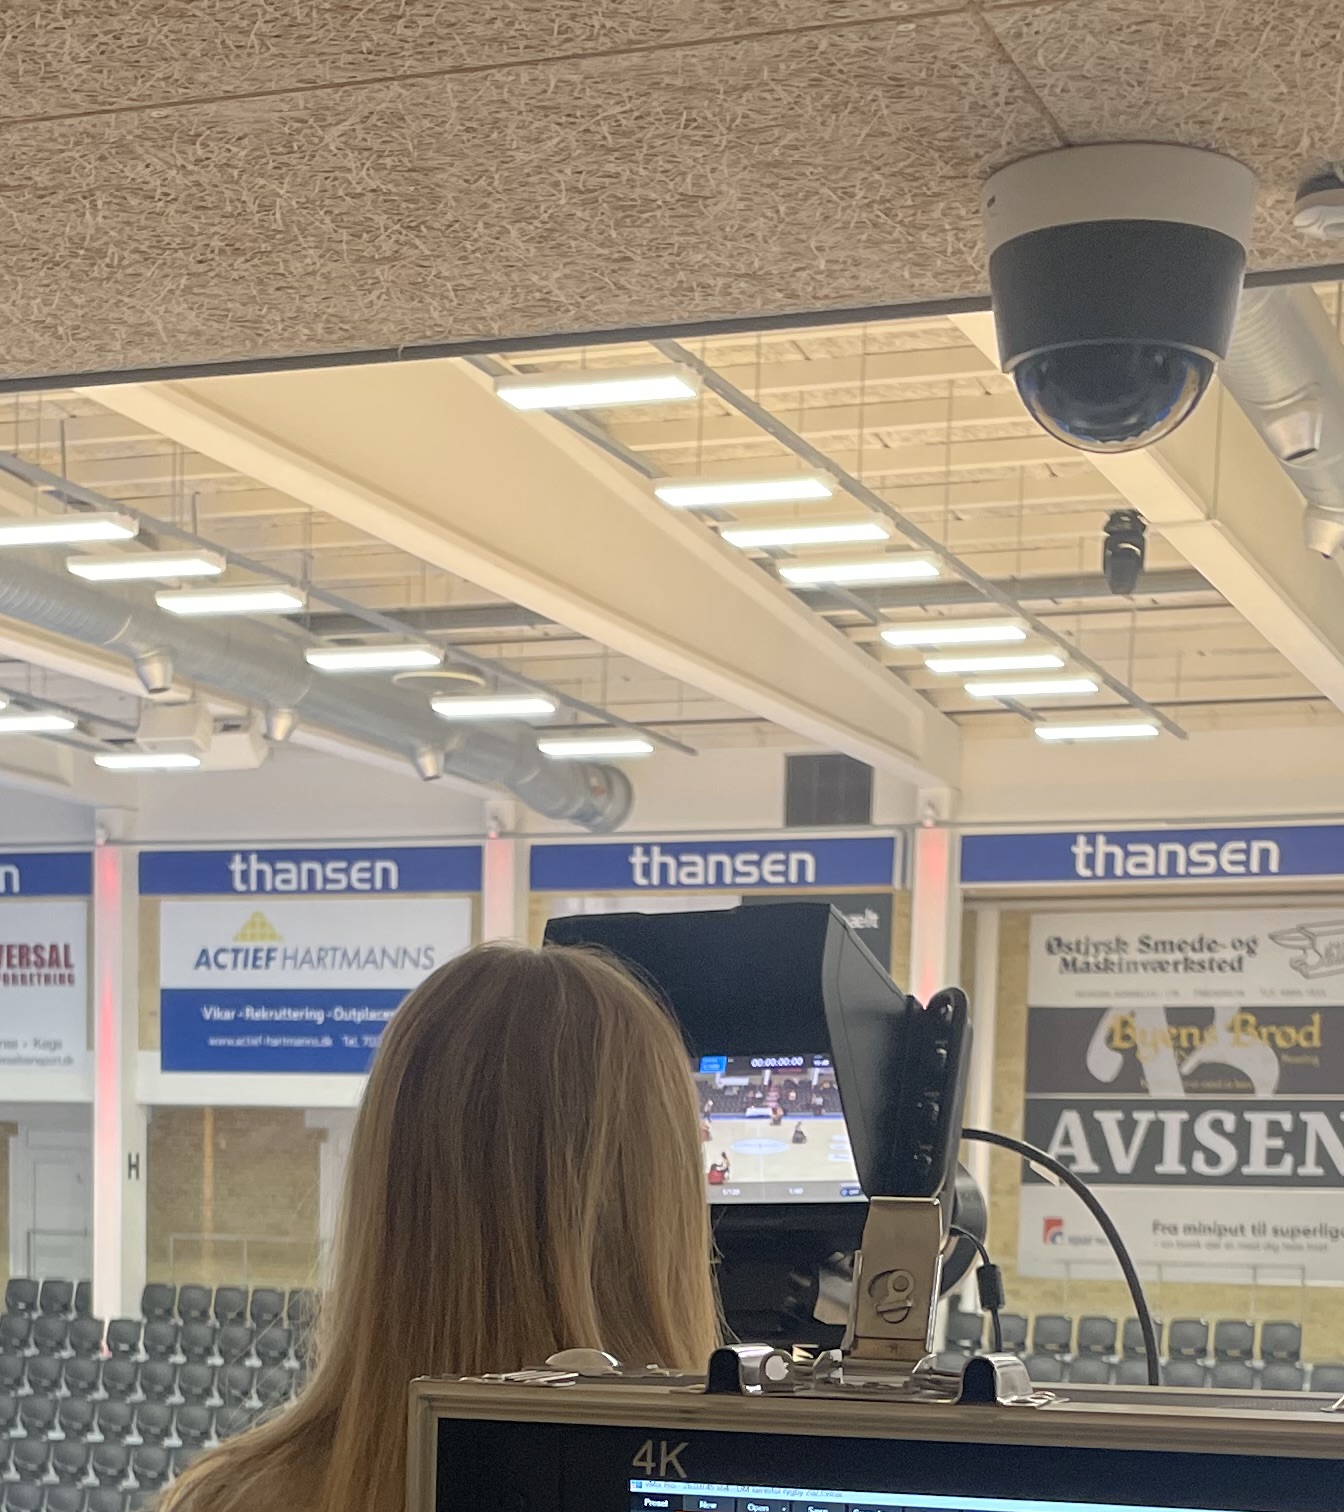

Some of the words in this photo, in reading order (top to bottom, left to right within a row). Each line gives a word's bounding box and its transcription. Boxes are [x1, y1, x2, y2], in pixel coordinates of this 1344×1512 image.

[629, 844, 816, 886] thansen
[1071, 834, 1280, 878] thansen
[229, 853, 399, 892] thansen
[194, 947, 277, 971] ACTIEF
[281, 946, 435, 971] HARTMANNS
[1046, 936, 1129, 957] Østjysk
[1231, 939, 1258, 957] og
[1057, 956, 1244, 975] Maskinværksted
[127, 1153, 140, 1179] H
[1152, 1219, 1178, 1235] Fra
[1183, 1220, 1247, 1240] miniput
[1251, 1222, 1268, 1237] til
[632, 1440, 689, 1479] 4K
[643, 1498, 669, 1508] Preset
[700, 1500, 718, 1510] New
